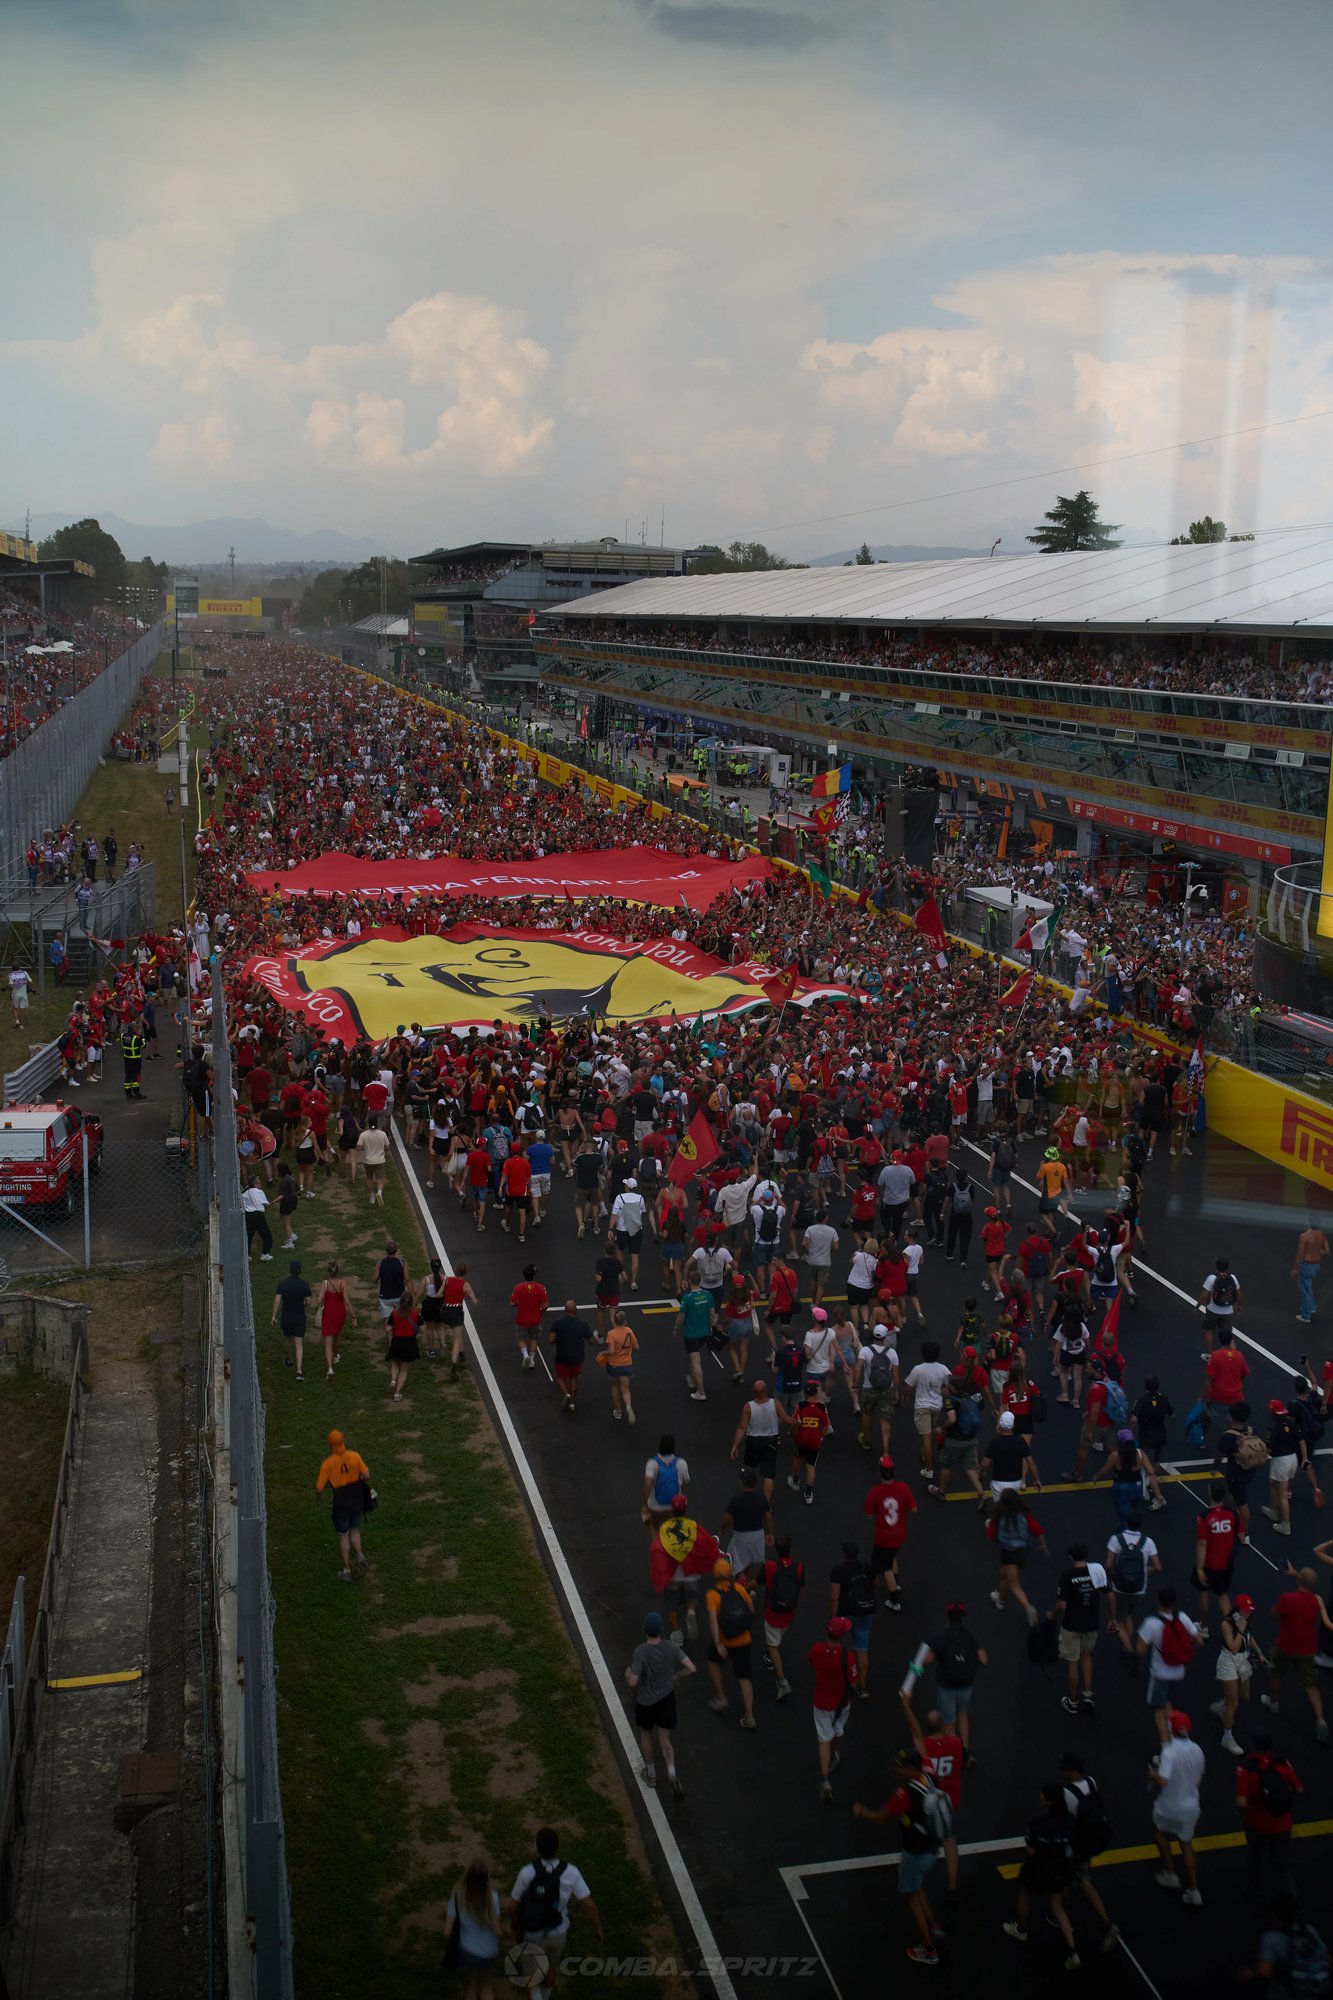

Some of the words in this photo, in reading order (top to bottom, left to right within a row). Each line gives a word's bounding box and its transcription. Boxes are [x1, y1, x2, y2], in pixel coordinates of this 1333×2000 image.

[207, 602, 243, 612] PIRELLI
[1032, 703, 1054, 714] DHL
[1070, 707, 1091, 719] DHL
[1109, 712, 1132, 725] DHL
[1153, 717, 1181, 731] DHL
[1201, 722, 1231, 737] DHL
[1256, 729, 1289, 743] DHL
[1032, 768, 1053, 781] DHL
[1072, 776, 1094, 790] DHL
[1115, 785, 1141, 800] DHL
[1165, 793, 1191, 810] DHL
[1218, 803, 1249, 821] DHL
[1278, 815, 1313, 834] DHL
[470, 875, 612, 887] FERRARI
[616, 870, 702, 885] CB
[552, 930, 645, 953] Cuor
[0, 1183, 32, 1191] FIGHTING
[801, 1416, 820, 1428] 55
[883, 1496, 899, 1527] 3
[1210, 1519, 1232, 1534] 16
